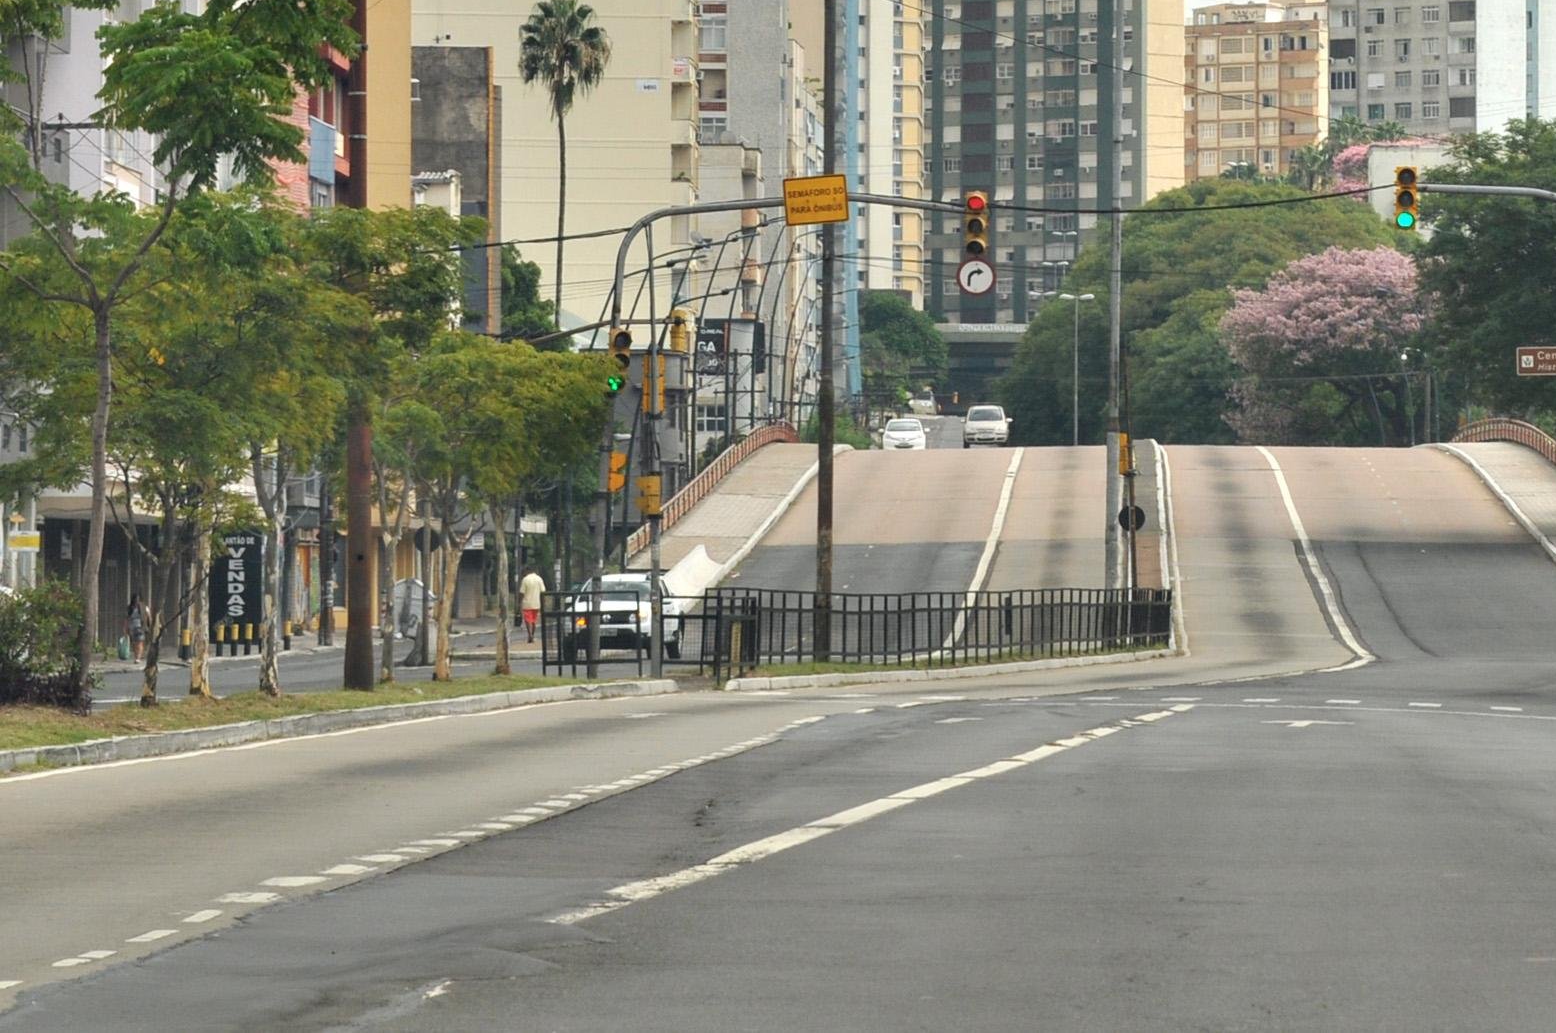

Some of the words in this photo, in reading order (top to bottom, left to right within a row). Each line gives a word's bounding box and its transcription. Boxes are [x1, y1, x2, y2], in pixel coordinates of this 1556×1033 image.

[791, 205, 812, 214] PARA
[246, 536, 255, 545] DE
[226, 547, 246, 617] VENDAS
